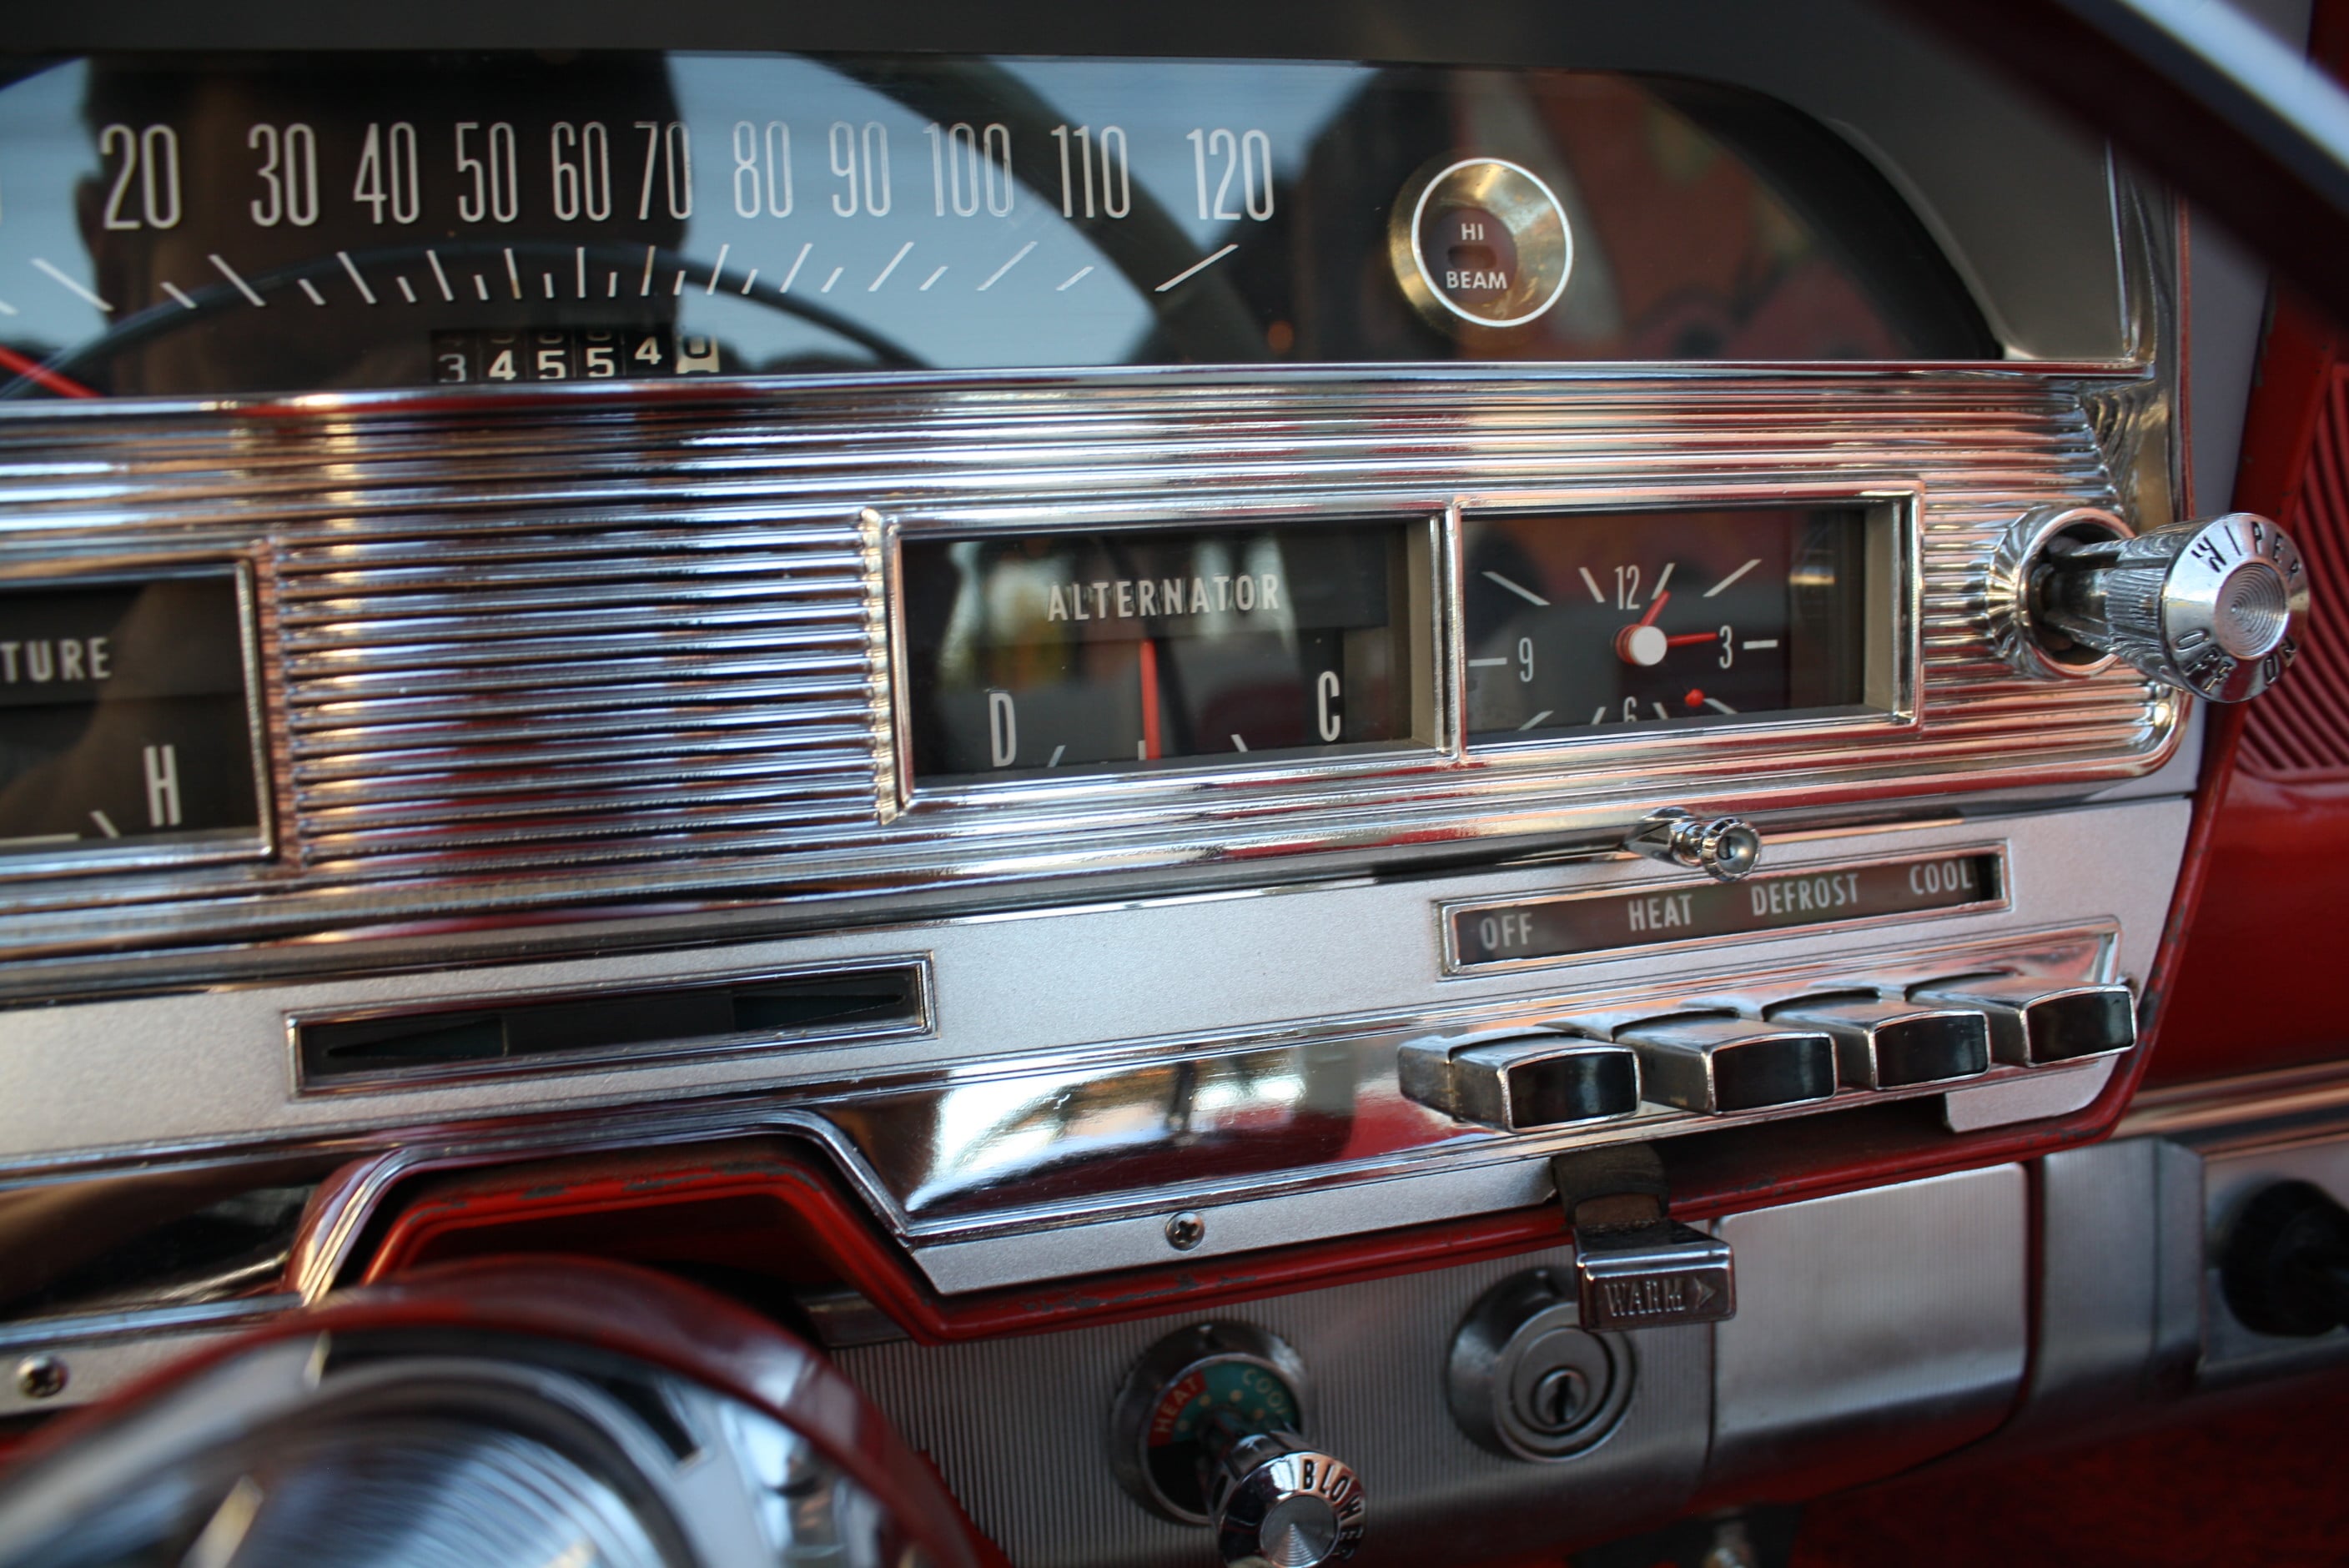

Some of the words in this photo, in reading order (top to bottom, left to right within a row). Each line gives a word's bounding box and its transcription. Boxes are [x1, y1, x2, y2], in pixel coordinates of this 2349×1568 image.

[100, 123, 180, 230] 20
[249, 123, 319, 228] 30
[353, 122, 419, 225] 40
[455, 121, 519, 224] 50
[551, 121, 611, 222] 60
[634, 121, 693, 220] 70
[732, 120, 793, 219] 80
[828, 120, 892, 219] 90
[922, 122, 1016, 219] 100
[1049, 125, 1131, 219] 110
[1185, 128, 1276, 222] 120
[1461, 223, 1485, 241] HI
[1445, 270, 1508, 290] BEAM
[2190, 520, 2302, 585] WIPER
[1048, 573, 1280, 621] ALTERNATOR
[1614, 564, 1641, 611] 12
[1518, 636, 1535, 683] 9
[1718, 625, 1733, 670] 3
[988, 690, 1017, 768] D
[1317, 670, 1341, 742] C
[143, 743, 184, 828] H
[1479, 912, 1534, 951] OFF
[1628, 893, 1694, 932] HEAT
[1751, 872, 1861, 917] DEFROST
[1909, 858, 1974, 897] COOL
[1603, 1279, 1685, 1317] WARM
[1154, 1376, 1200, 1434] HEAT
